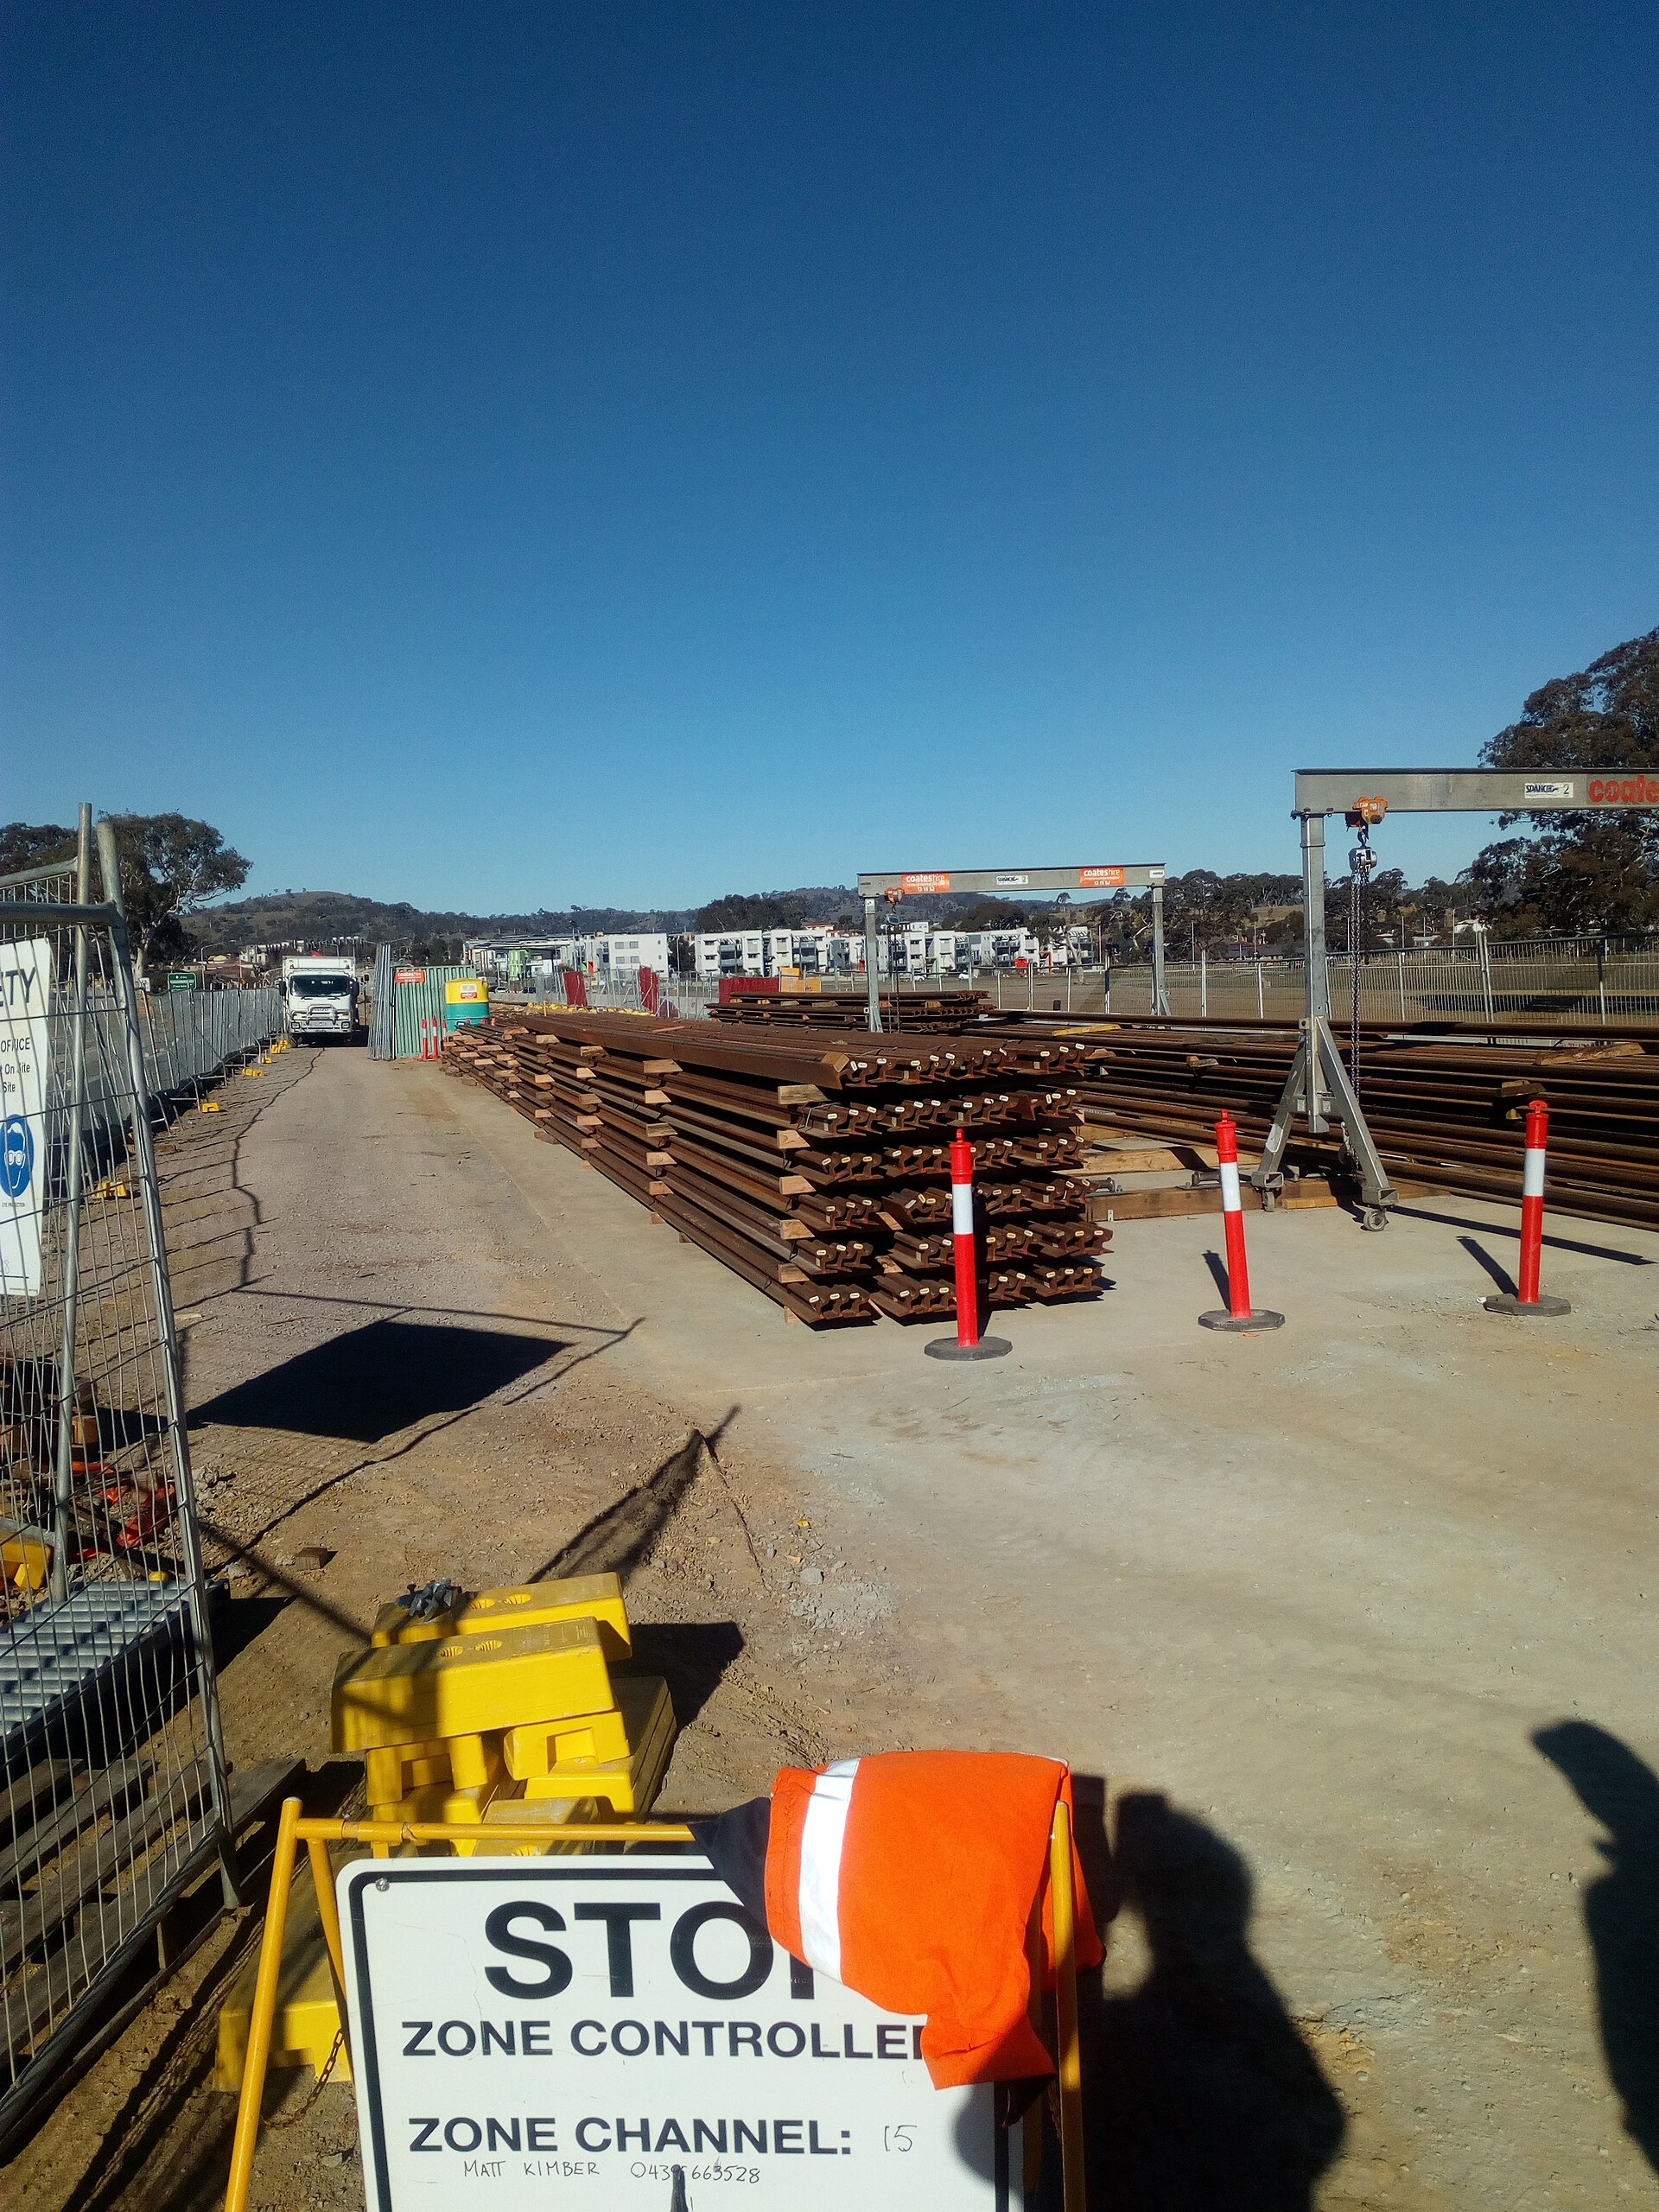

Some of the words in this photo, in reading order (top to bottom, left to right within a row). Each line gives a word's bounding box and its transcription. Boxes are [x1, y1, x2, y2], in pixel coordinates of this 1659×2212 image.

[1563, 784, 1570, 794] 2
[4, 1064, 15, 1075] On
[17, 1063, 30, 1074] ite
[485, 1901, 815, 1999] STO
[402, 2021, 553, 2056] ZONE
[409, 2117, 558, 2152] ZONE
[575, 2117, 852, 2155] CHANNEL:
[884, 2125, 918, 2152] 15
[464, 2161, 506, 2177] MATT
[524, 2162, 600, 2177] KIMBER
